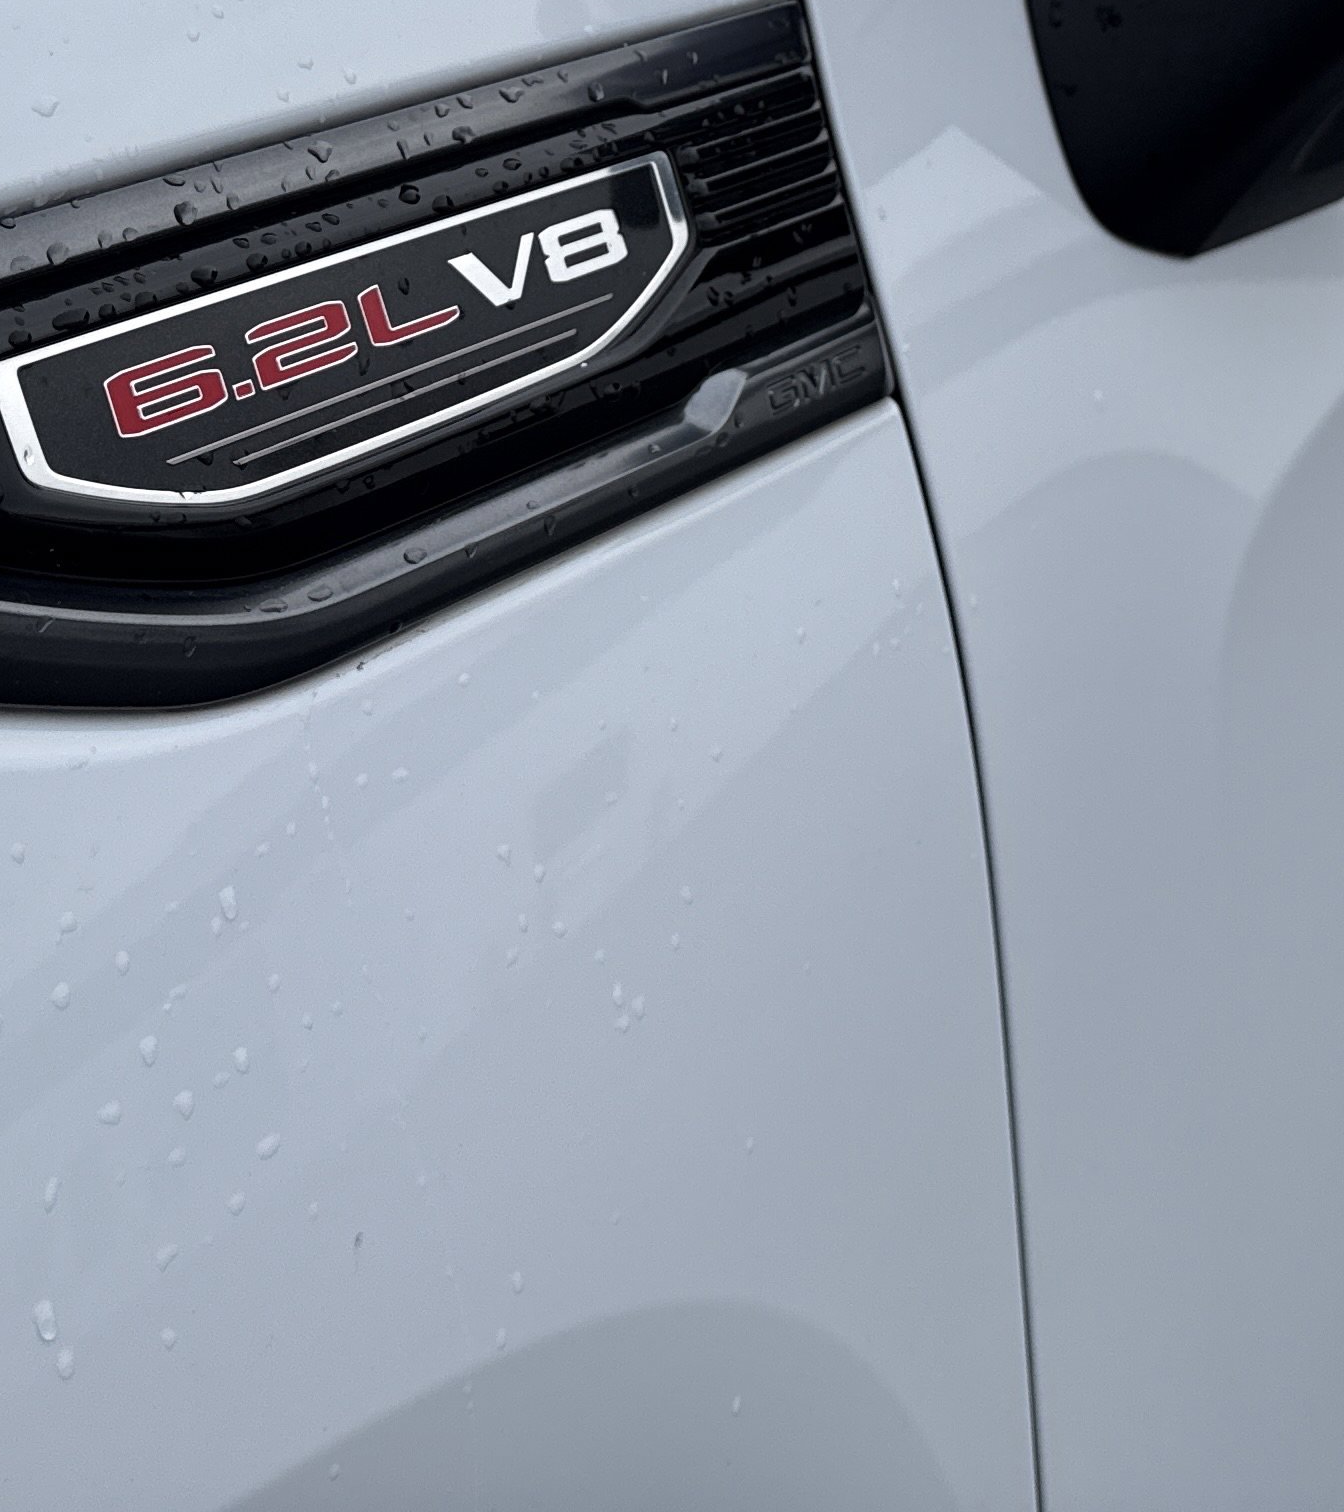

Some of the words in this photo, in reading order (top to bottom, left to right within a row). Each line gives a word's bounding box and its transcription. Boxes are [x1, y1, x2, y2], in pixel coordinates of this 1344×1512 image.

[103, 283, 461, 438] 6.2L
[447, 208, 629, 308] V8
[767, 344, 867, 416] GMC
